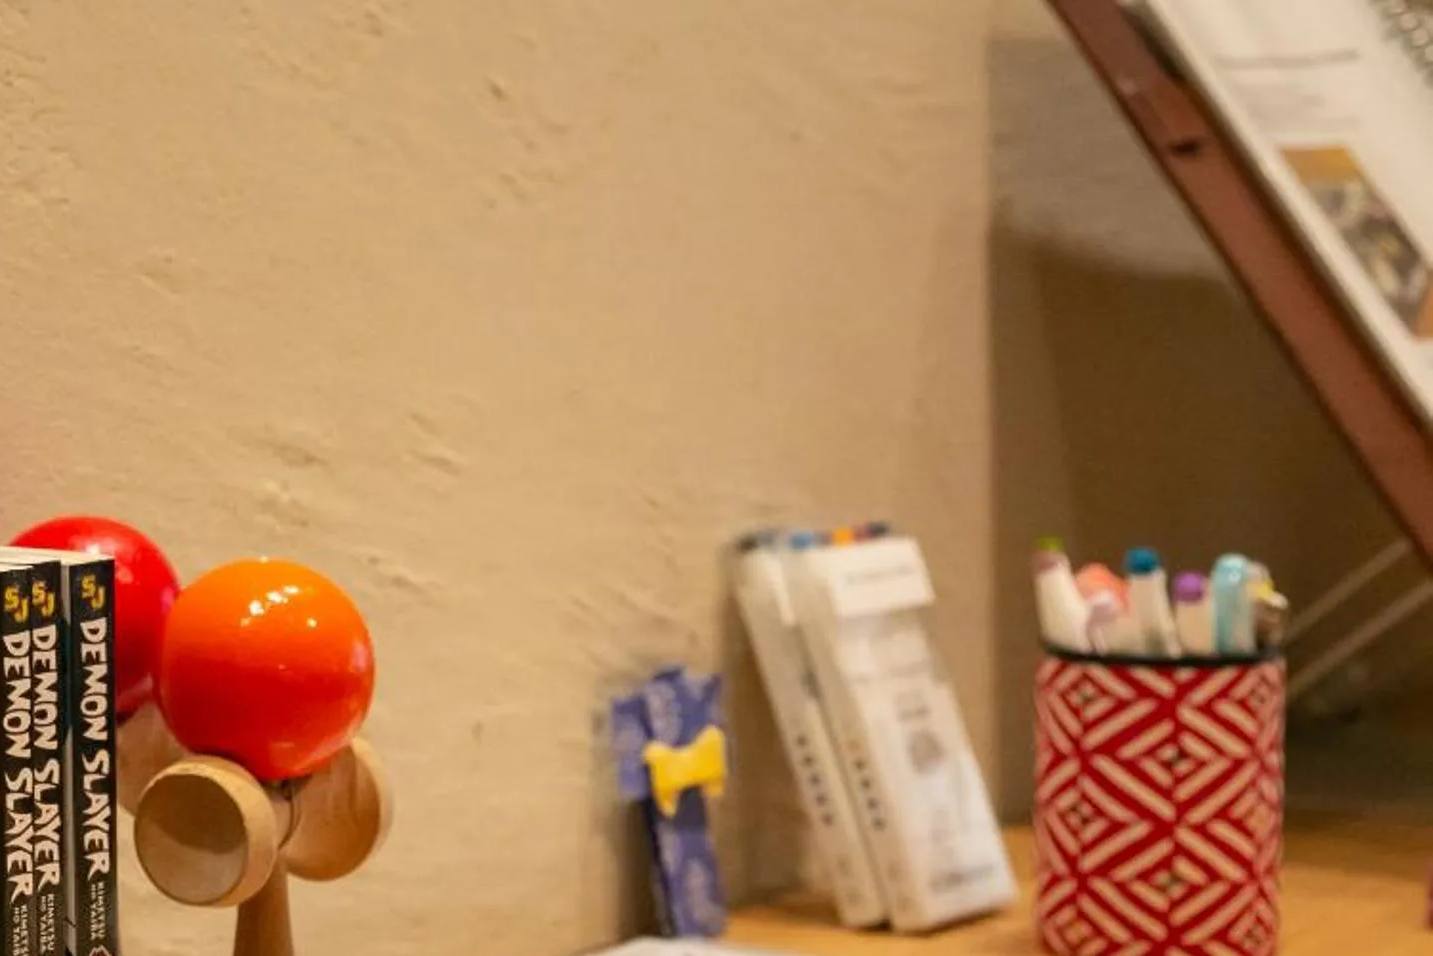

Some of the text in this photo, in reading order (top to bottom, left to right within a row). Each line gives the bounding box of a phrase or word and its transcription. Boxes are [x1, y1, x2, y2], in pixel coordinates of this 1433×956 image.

[4, 585, 28, 623] SJ
[32, 580, 55, 616] SJ
[81, 573, 103, 609] SJ
[2, 631, 34, 902] DEMON SLAYER
[33, 624, 61, 890] DEMON SLAYER
[79, 617, 110, 880] DEMON SLAYER
